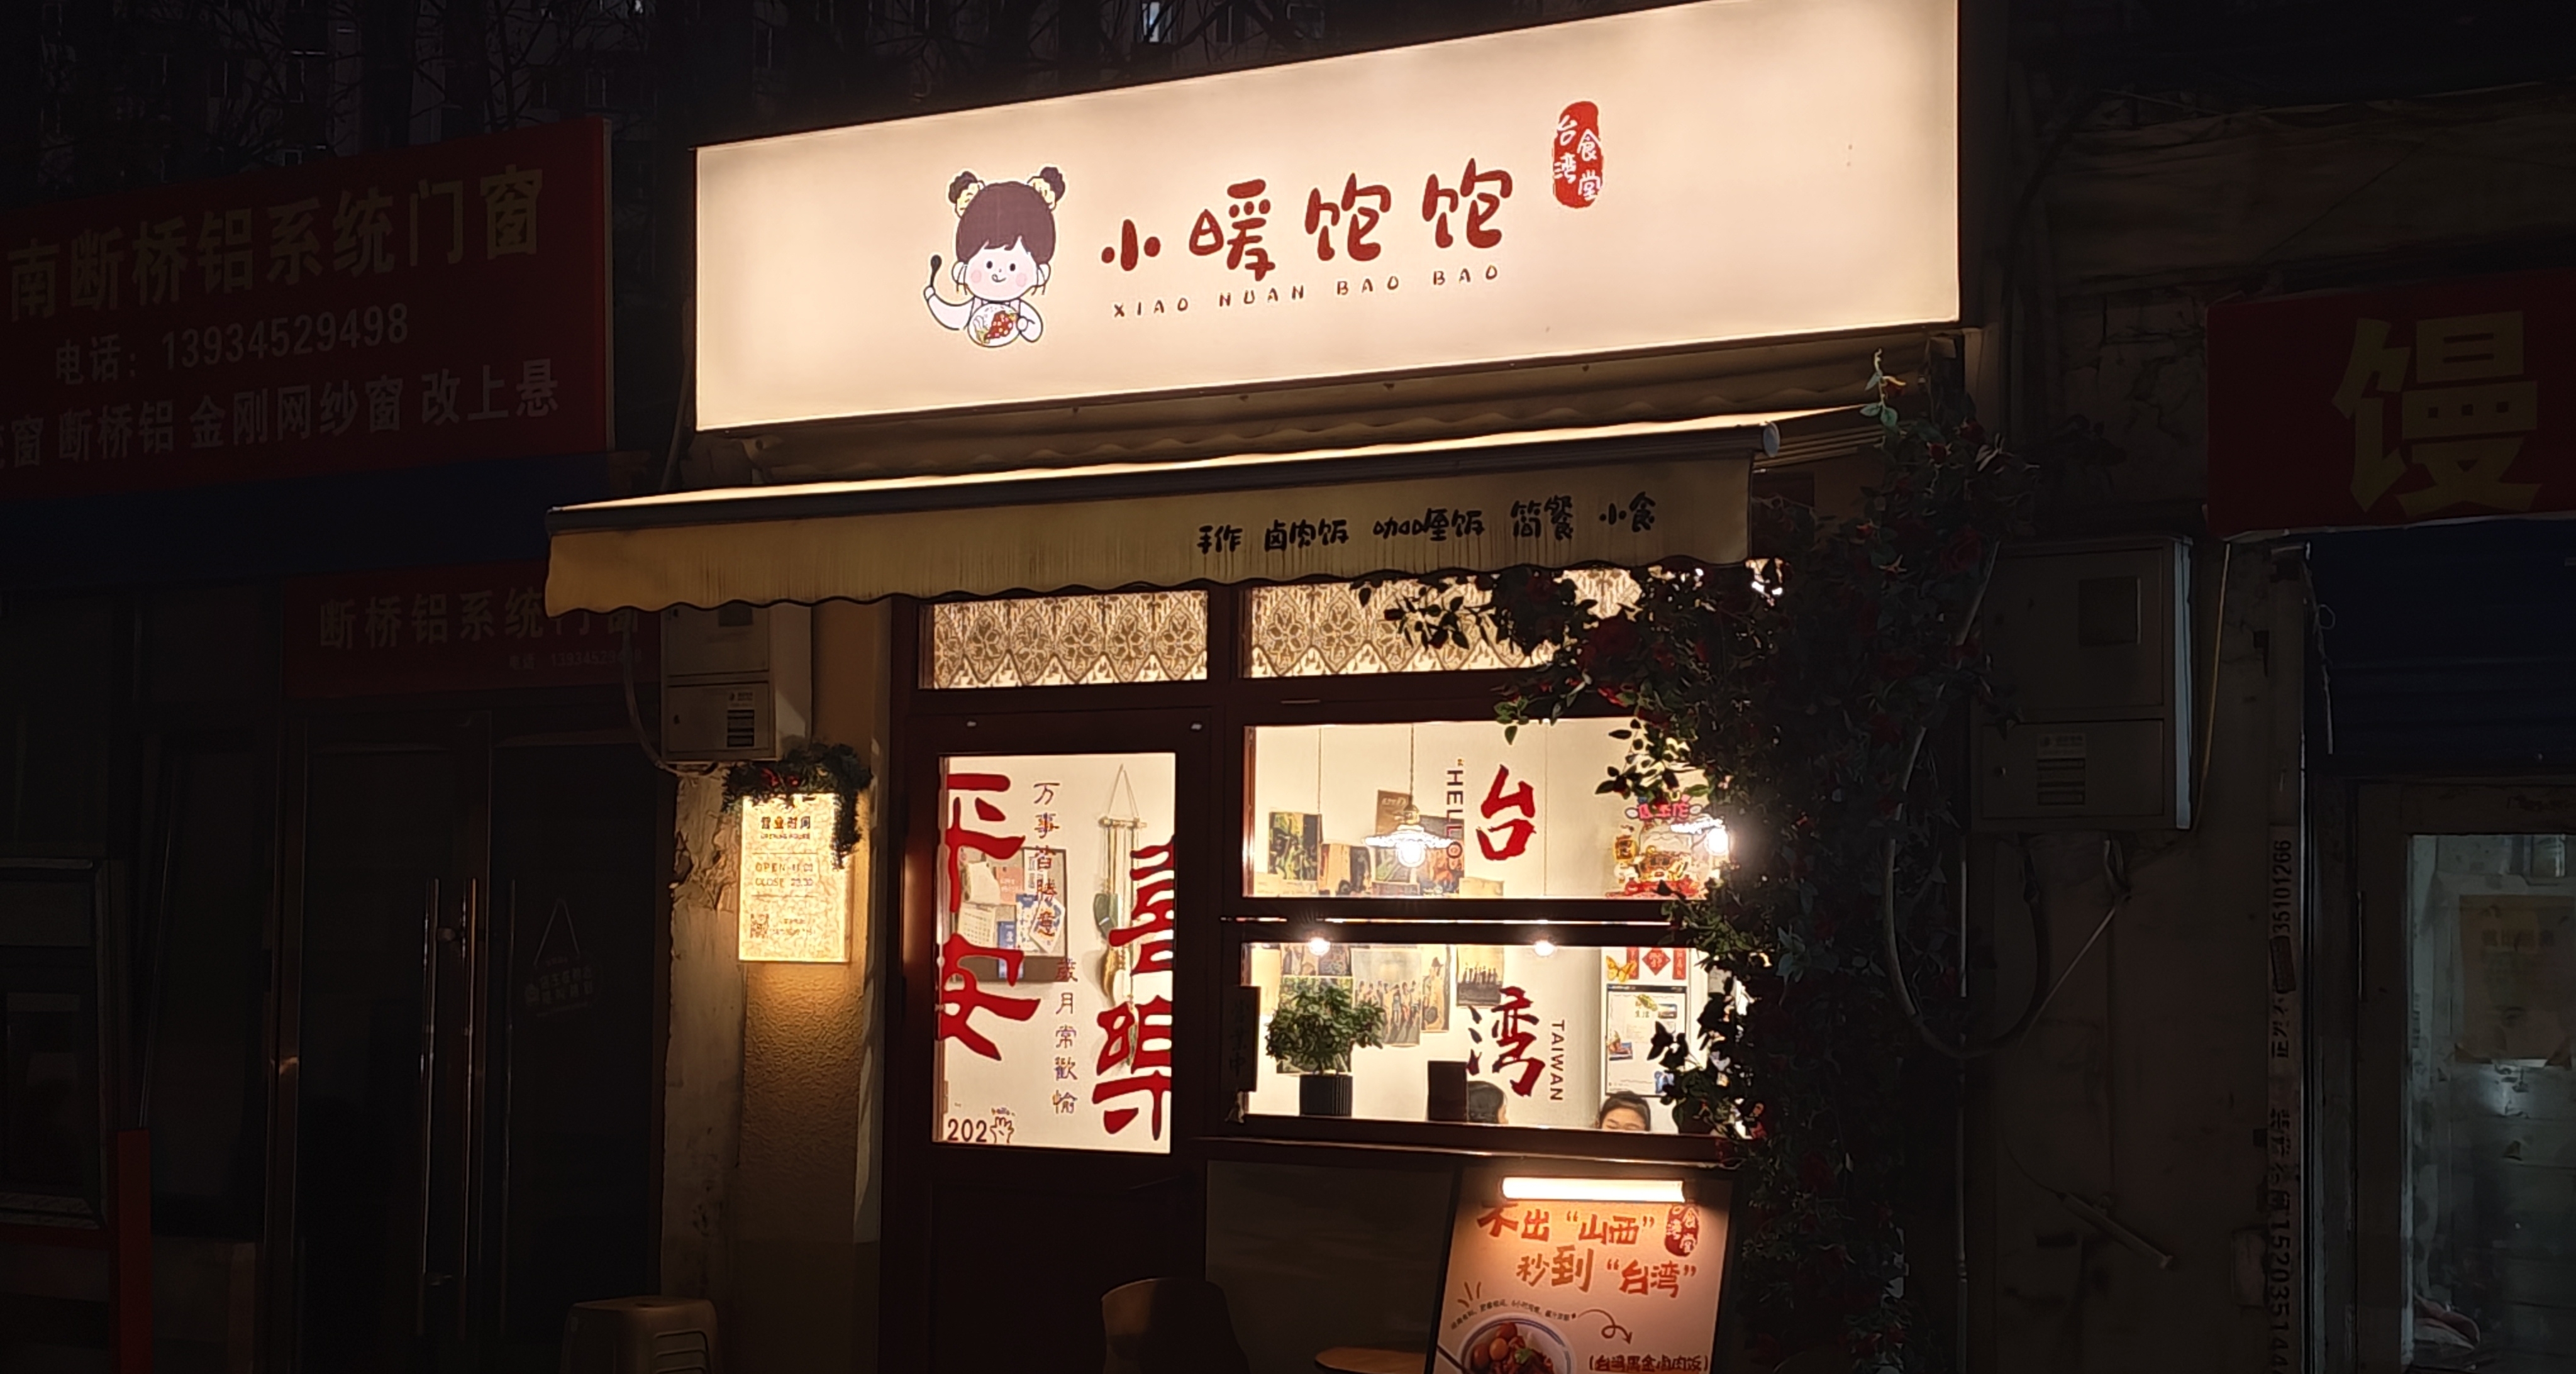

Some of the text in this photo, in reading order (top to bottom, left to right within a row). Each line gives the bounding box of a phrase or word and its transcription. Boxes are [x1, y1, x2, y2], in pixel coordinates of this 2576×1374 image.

[1553, 114, 1578, 184] 台湾
[1576, 128, 1603, 201] 食堂
[8, 163, 543, 323] 南断桥铝系统门窗
[1101, 158, 1513, 282] 小暖饱饱
[1113, 265, 1499, 318] XIAO NUAN BAO BAO
[162, 302, 409, 371] 13934529498
[0, 357, 560, 471] 窗 断桥铝 金刚网纱窗 改上悬
[2331, 310, 2542, 517] 馒
[1196, 491, 1657, 555] 手作 卤肉饭 咖喱饭 简餐 小食
[551, 648, 642, 667] 1393452948
[1446, 770, 1463, 859] HELLO
[755, 863, 786, 873] OPEN
[1550, 1018, 1565, 1102] TAIWAN
[2270, 1217, 2290, 1374] 152035144
